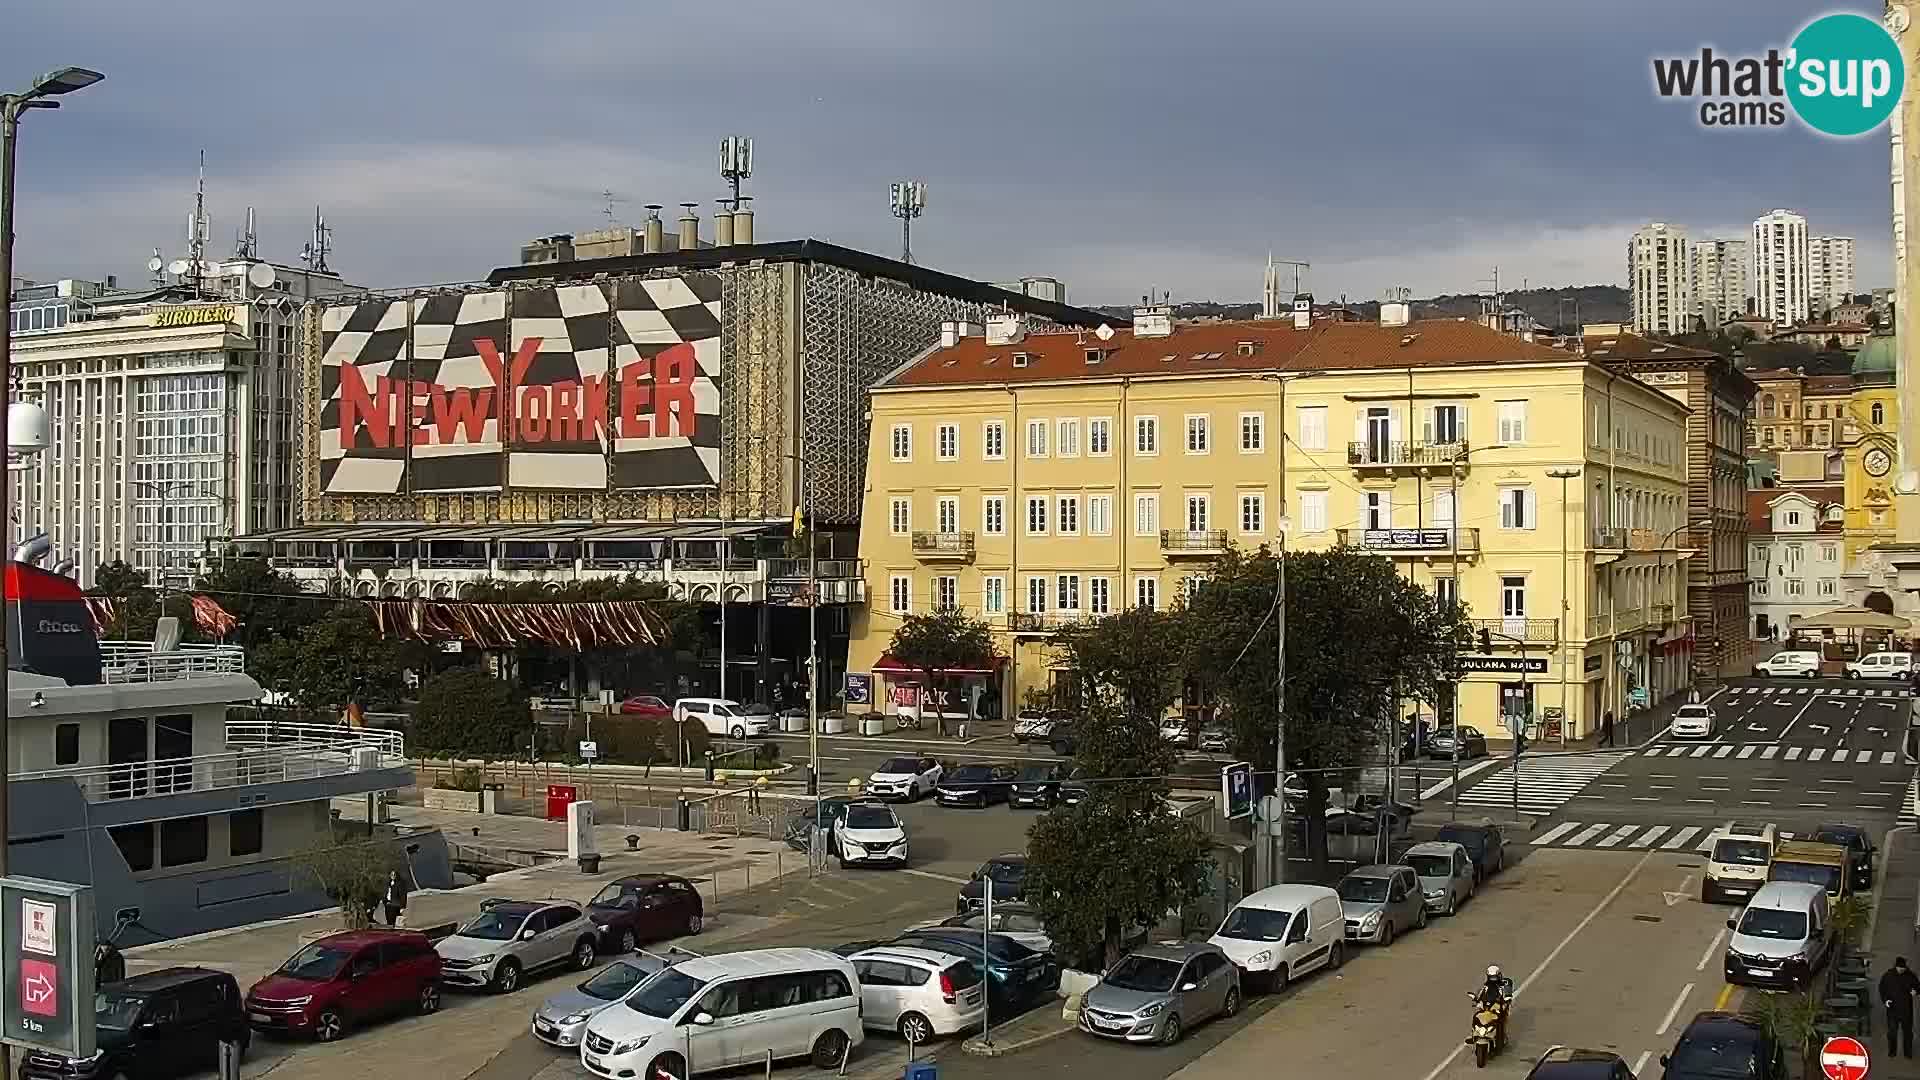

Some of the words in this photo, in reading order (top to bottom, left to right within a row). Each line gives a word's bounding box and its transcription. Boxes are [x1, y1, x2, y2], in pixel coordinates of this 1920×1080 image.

[1460, 661, 1506, 669] JULIANA
[1510, 662, 1542, 670] NAILS
[22, 1017, 29, 1029] 5
[30, 1019, 43, 1033] km
